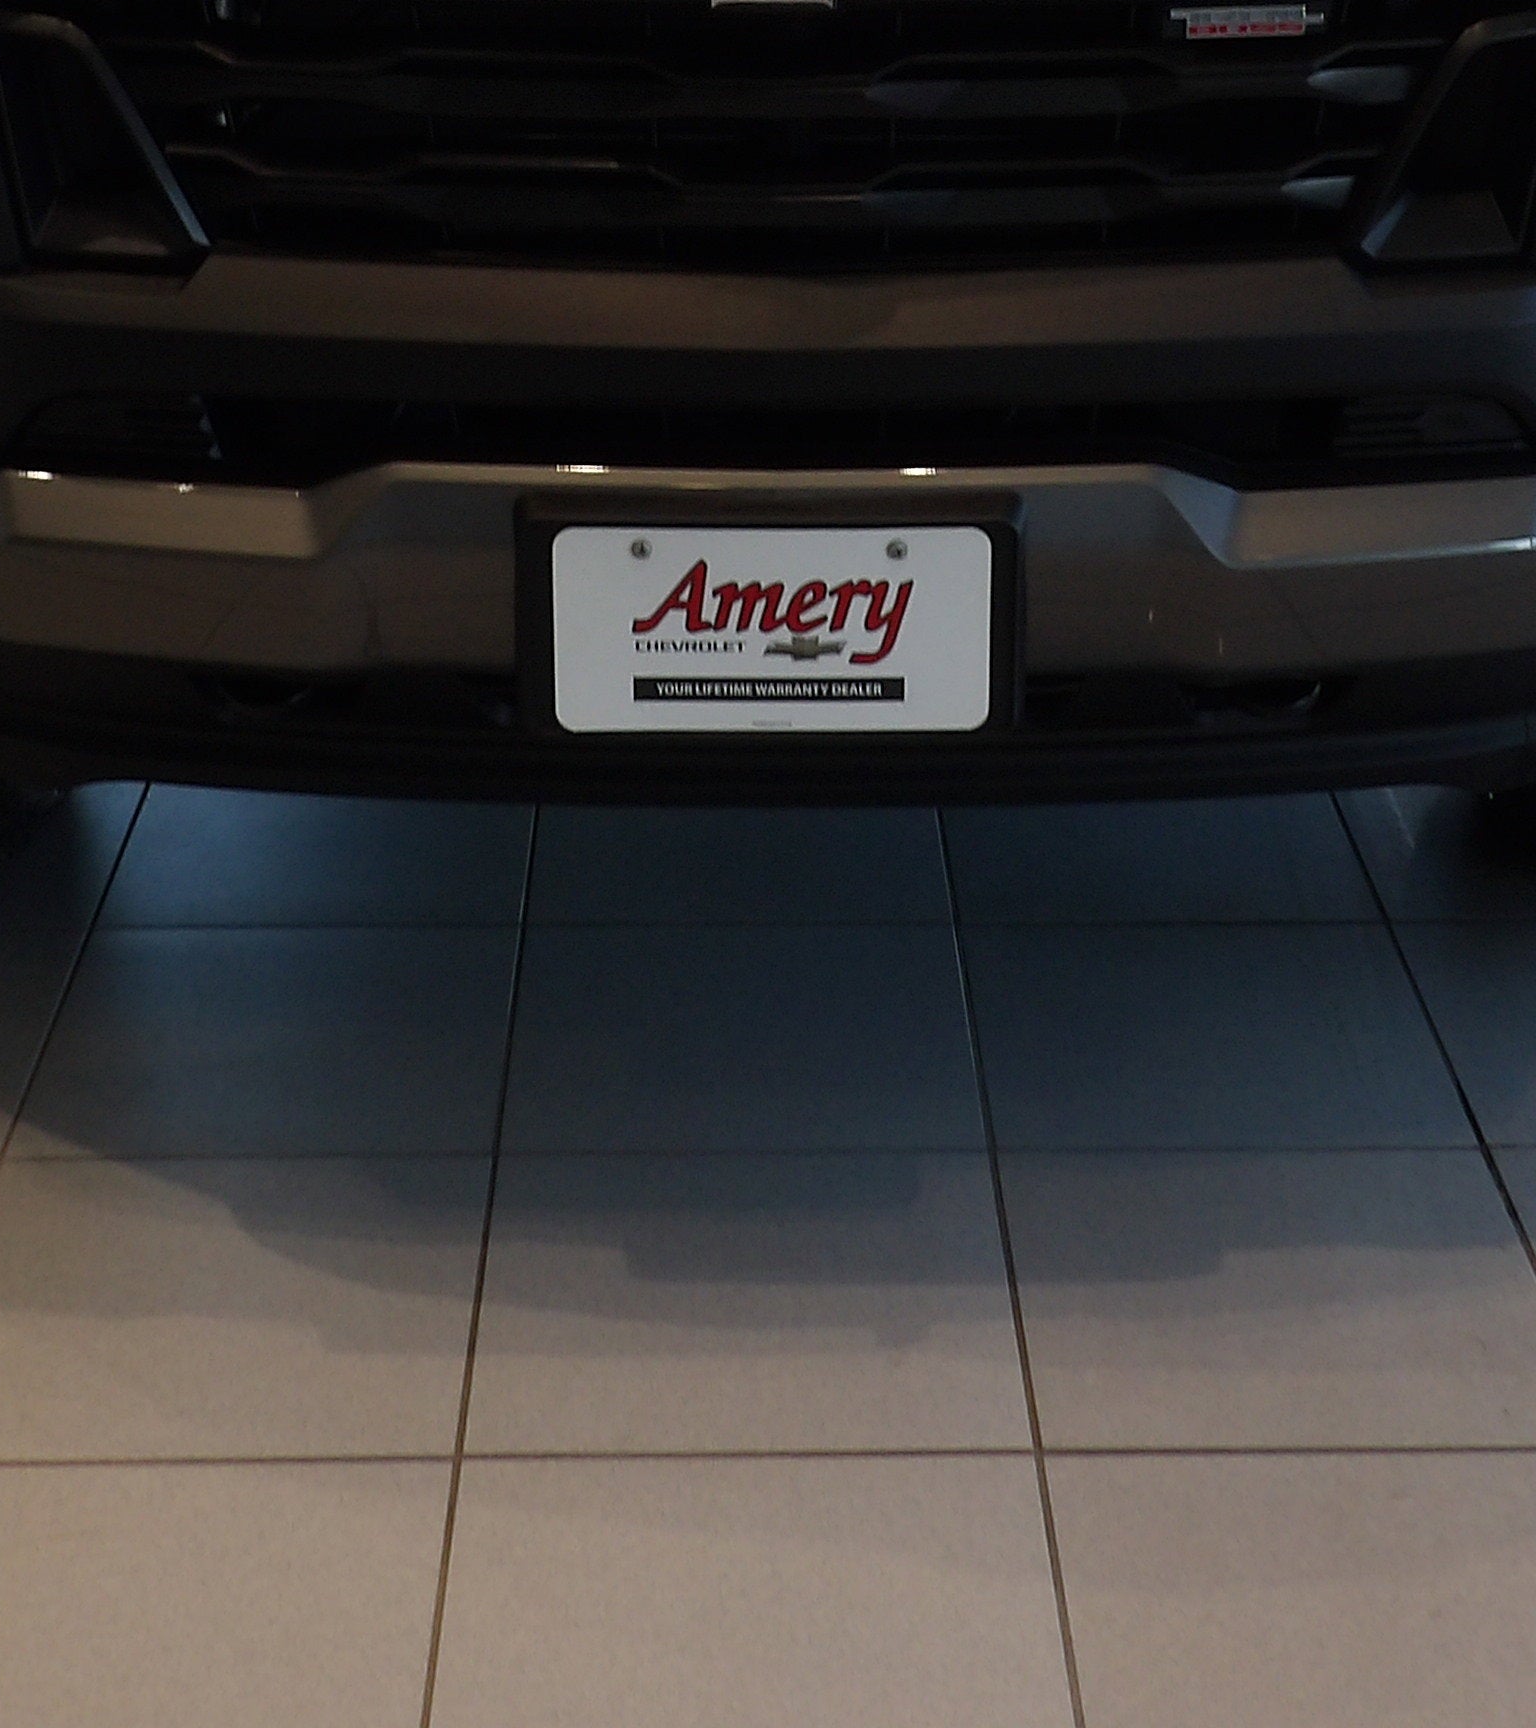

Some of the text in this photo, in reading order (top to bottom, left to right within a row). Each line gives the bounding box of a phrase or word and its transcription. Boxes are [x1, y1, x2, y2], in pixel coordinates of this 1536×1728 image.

[632, 558, 914, 664] Amery
[634, 639, 745, 653] CHEVROLET
[657, 682, 883, 697] YOUR LIFETIME WARRANTY DEALER
